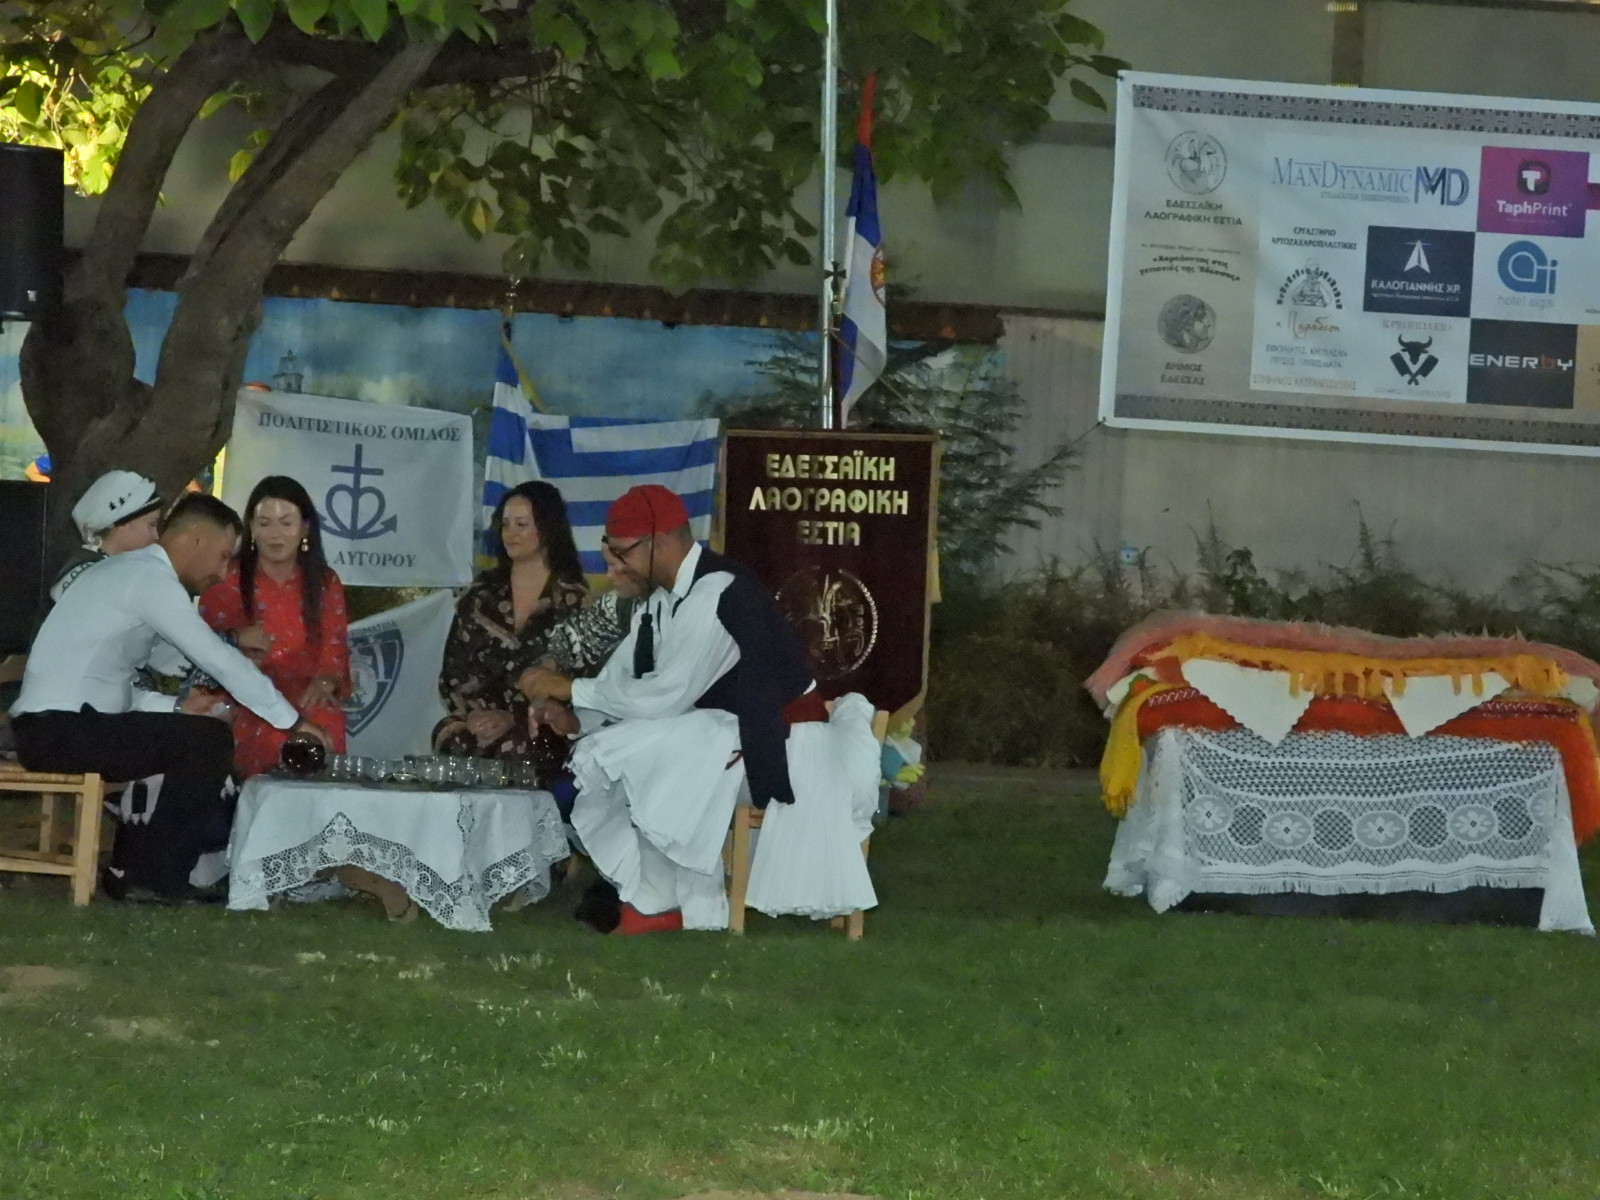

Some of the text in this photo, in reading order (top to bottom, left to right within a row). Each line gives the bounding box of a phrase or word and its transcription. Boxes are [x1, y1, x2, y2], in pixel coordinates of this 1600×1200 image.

[1496, 200, 1569, 216] TaphPrint
[1144, 211, 1242, 225] ΛΑΟΓΡΑΦΙΚΗ ΕΣΤΙΑ
[1371, 279, 1444, 293] ΚΑΛΟΓΙΑΝΝΗΣ
[1165, 362, 1203, 372] ΔΗΜΟΣ
[1160, 374, 1205, 386] ΕΔΕΣΣΑΣ
[258, 412, 461, 442] ΠΟΛΙΤΙΣΤΙΚΟΣ ΟΜΙΛΟΣ
[766, 450, 895, 481] ΕΔΕΣΣΑΪΚΗ
[749, 486, 909, 515] ΛΑΟΓΡΑΦΙΚΗ
[799, 520, 861, 546] ΕΣΤΙΑ
[333, 551, 416, 568] ΑΥΓΟΡΟΥ
